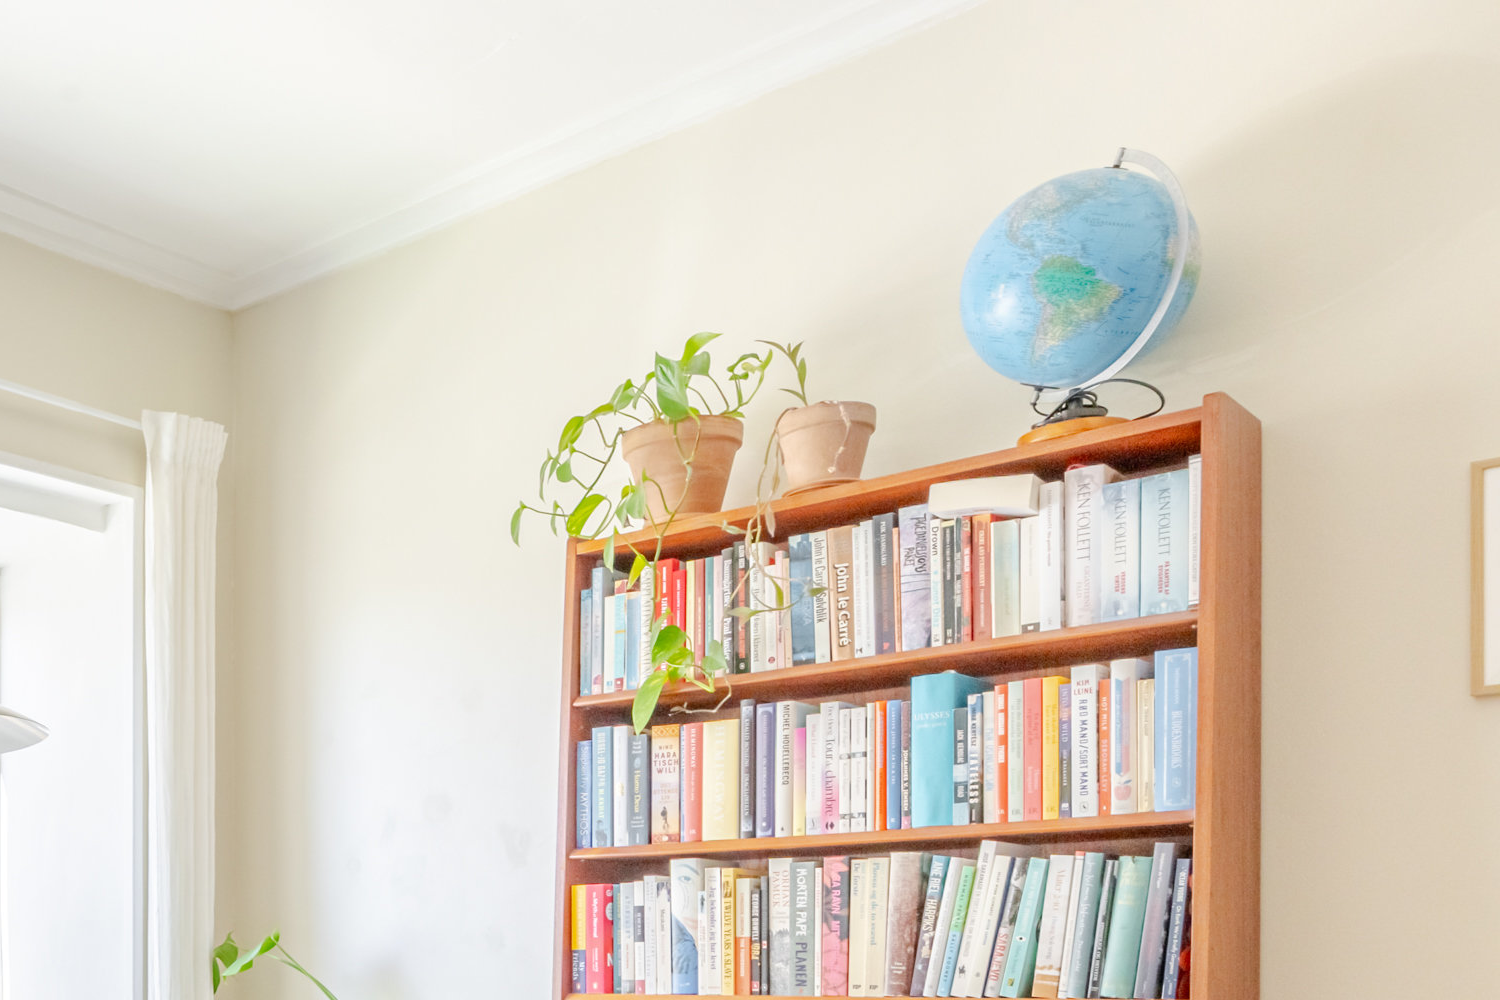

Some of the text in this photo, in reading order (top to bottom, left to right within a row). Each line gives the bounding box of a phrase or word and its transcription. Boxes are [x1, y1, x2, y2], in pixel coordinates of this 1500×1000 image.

[1077, 482, 1091, 562] KEN FOLLETT
[1114, 498, 1127, 568] KEN FOLLETT
[1157, 487, 1172, 557] KEN FOLLETT
[813, 537, 825, 557] John
[931, 526, 939, 556] Drown
[814, 557, 826, 565] le
[833, 562, 852, 647] John le Carré
[1073, 687, 1093, 695] LEINE
[1077, 679, 1090, 687] KIM
[913, 710, 950, 720] ULYSSES
[1079, 699, 1089, 717] RØD
[781, 704, 790, 786] MICHEL HOUELLEBECQ
[957, 729, 965, 741] JACK
[1171, 710, 1182, 769] BUDDENBROOKS
[825, 739, 835, 760] Tour
[579, 775, 588, 789] Fry
[715, 726, 725, 823] HEMINGWAY
[969, 753, 979, 804] FATELESS
[1079, 771, 1089, 796] MAND
[825, 770, 836, 817] chambre
[579, 792, 589, 836] MYTHOS
[853, 863, 860, 873] De
[977, 864, 988, 890] SARAMAGO
[1178, 871, 1186, 886] OCEAN
[708, 886, 717, 898] Jeg
[772, 871, 780, 908] PAMUK
[871, 890, 878, 899] og
[922, 860, 944, 932] ANE RIEL HARPIKS
[751, 893, 759, 916] GEORGE
[831, 890, 841, 914] RAVN
[872, 901, 879, 912] de
[954, 875, 969, 928] NORMAL PEOPLE
[708, 899, 717, 931] bekender,
[723, 900, 733, 927] TWELVE
[871, 913, 877, 921] to
[708, 931, 716, 941] jeg
[751, 917, 759, 941] ORWELL
[795, 868, 808, 987] MORTEN PAPE PLANEN
[831, 920, 841, 936] MIT
[723, 928, 733, 951] YEARS
[1171, 939, 1179, 953] Briefly
[579, 961, 585, 971] My
[709, 955, 717, 970] levet
[723, 958, 733, 979] SLAVE
[943, 933, 957, 982] SALLY ROONEY
[989, 933, 1009, 982] SARAJEVO
[1169, 953, 1177, 975] Gorgeous
